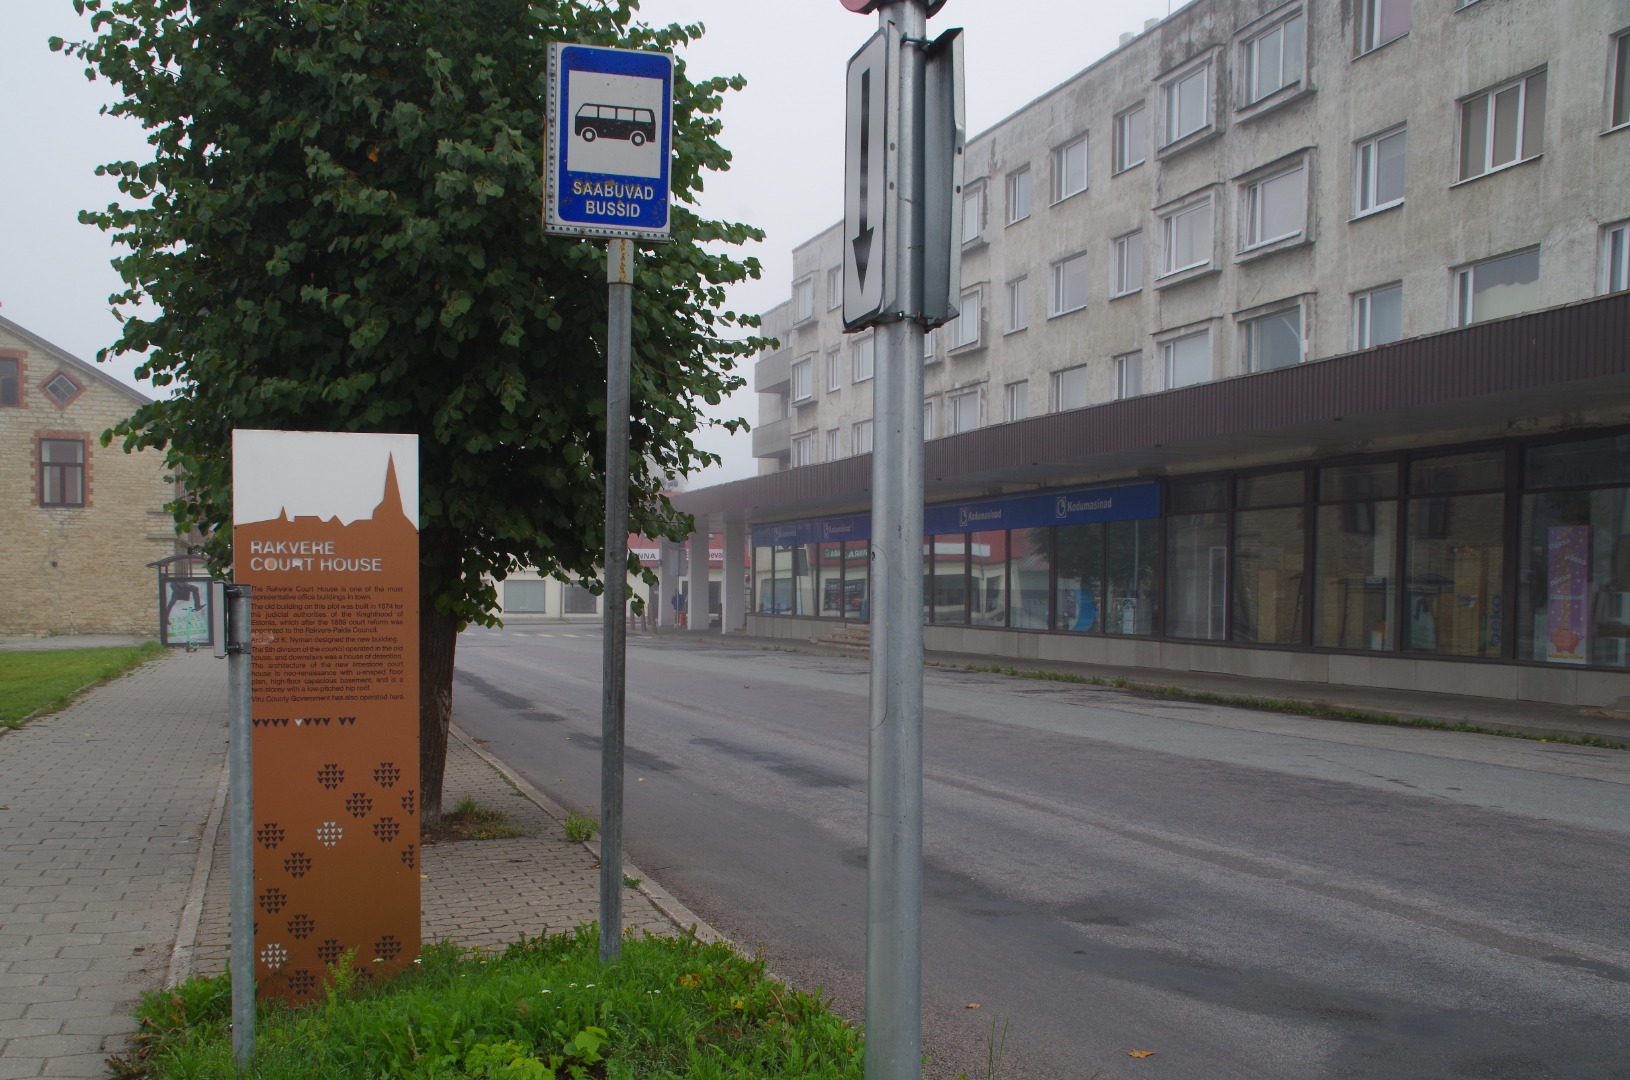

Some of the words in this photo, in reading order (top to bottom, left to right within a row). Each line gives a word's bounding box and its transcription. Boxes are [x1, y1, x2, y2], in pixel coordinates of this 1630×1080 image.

[573, 181, 654, 200] SAABUVAD
[585, 200, 641, 218] BUSSID
[1067, 497, 1112, 512] Kodumasinad
[250, 540, 336, 555] RAKVERE
[250, 557, 315, 572] COURT
[320, 557, 383, 572] HOUSE
[277, 603, 302, 611] building
[328, 603, 339, 611] plot
[356, 611, 392, 619] Knighthood
[1488, 594, 1502, 646] beko
[251, 686, 285, 694] two-storey
[345, 685, 355, 693] hip
[266, 696, 289, 704] County
[360, 694, 387, 702] operated
